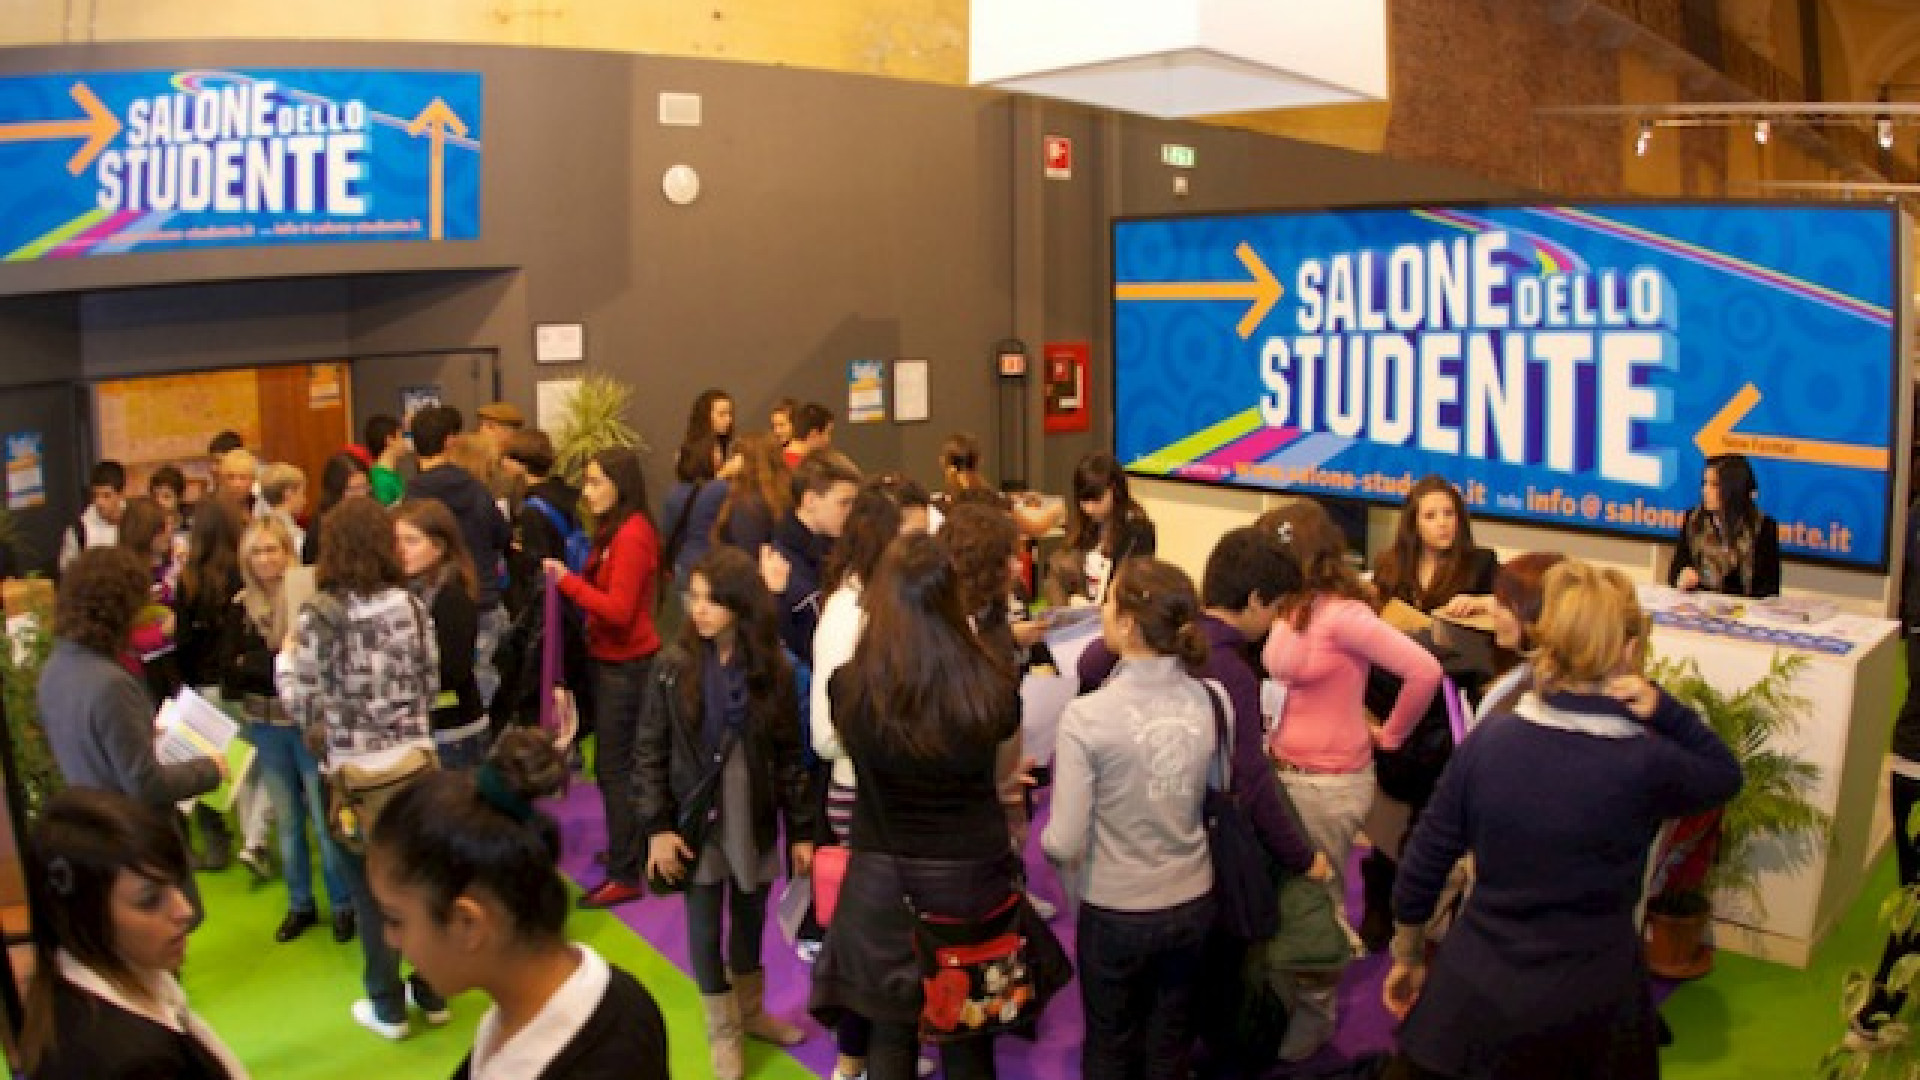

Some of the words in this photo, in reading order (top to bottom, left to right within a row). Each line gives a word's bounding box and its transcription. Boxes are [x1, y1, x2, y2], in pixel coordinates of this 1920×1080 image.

[127, 80, 279, 144] SALONE
[279, 101, 366, 134] DELLO
[97, 134, 369, 213] STUDENTE
[1295, 231, 1509, 333] SALONE
[1515, 265, 1664, 327] DELLO
[1259, 333, 1664, 487] STUDENTE
